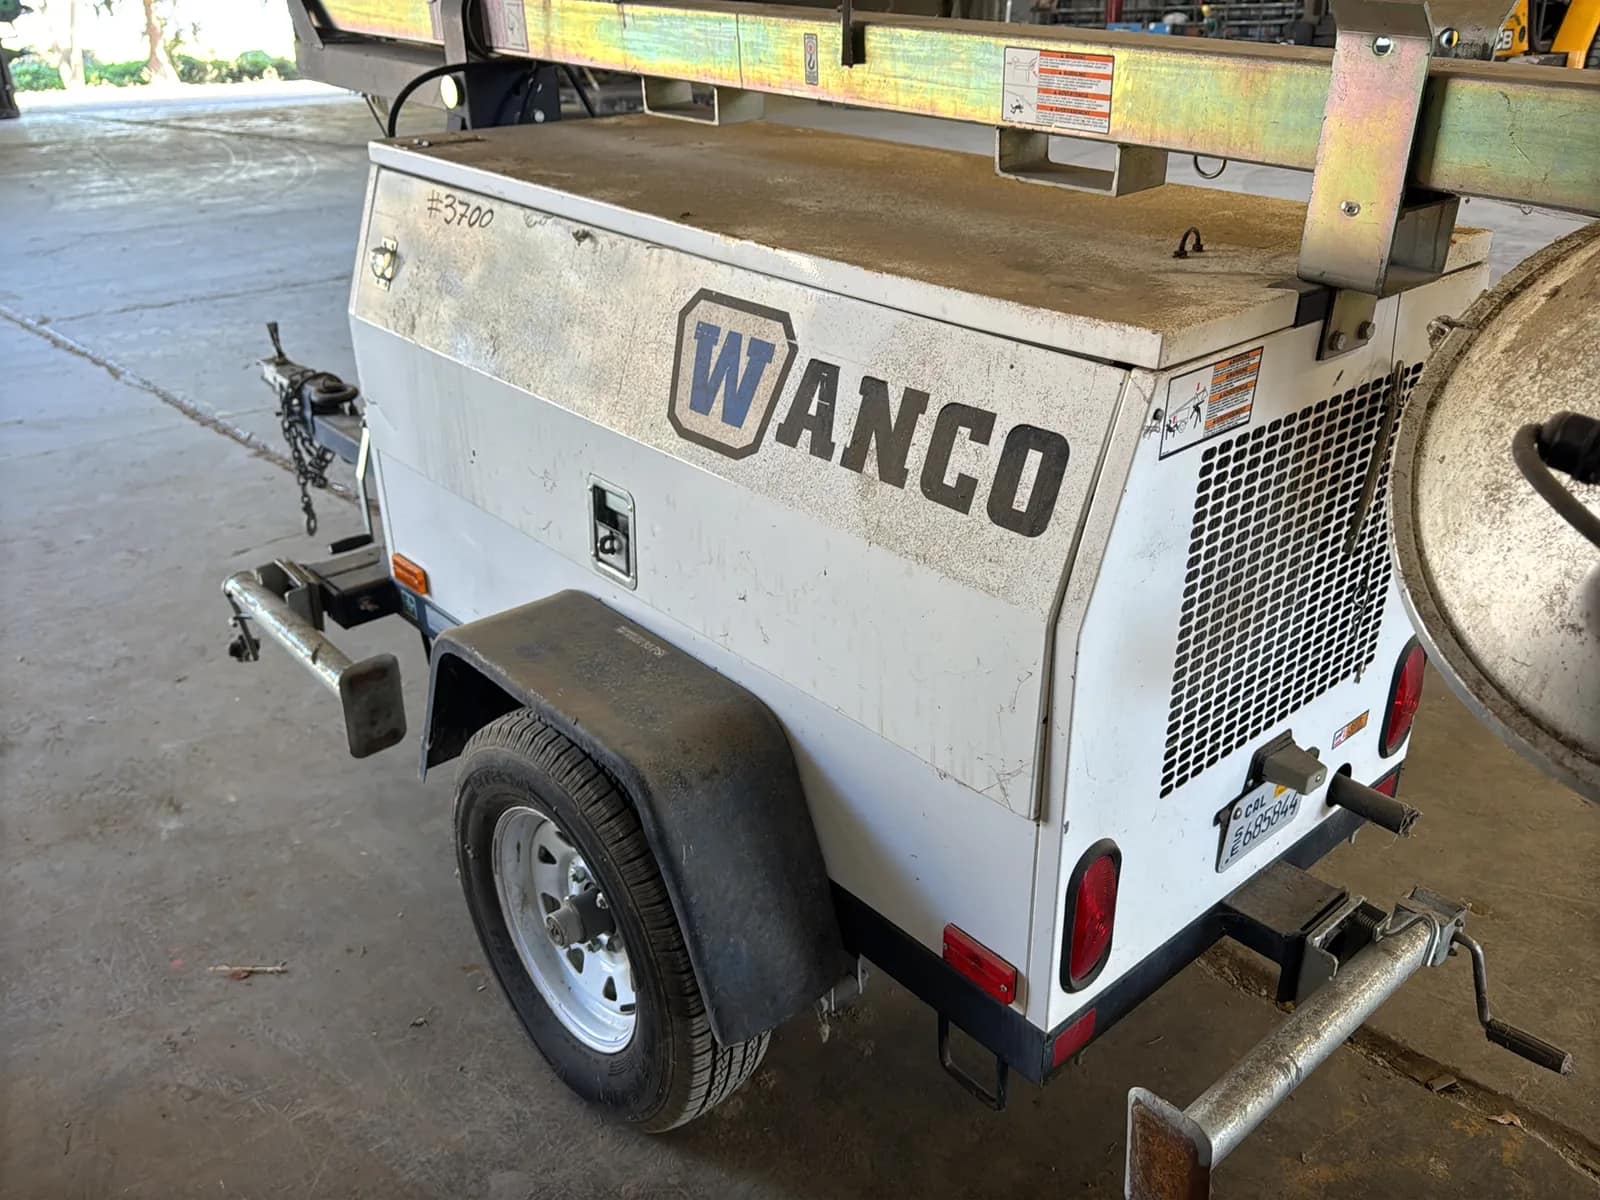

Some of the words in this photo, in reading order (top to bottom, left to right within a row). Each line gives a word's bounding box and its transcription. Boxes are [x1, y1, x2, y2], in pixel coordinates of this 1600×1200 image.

[427, 190, 494, 228] #3700
[689, 321, 1070, 538] WANCO
[1243, 793, 1298, 847] 685844
[1245, 795, 1266, 818] CAL
